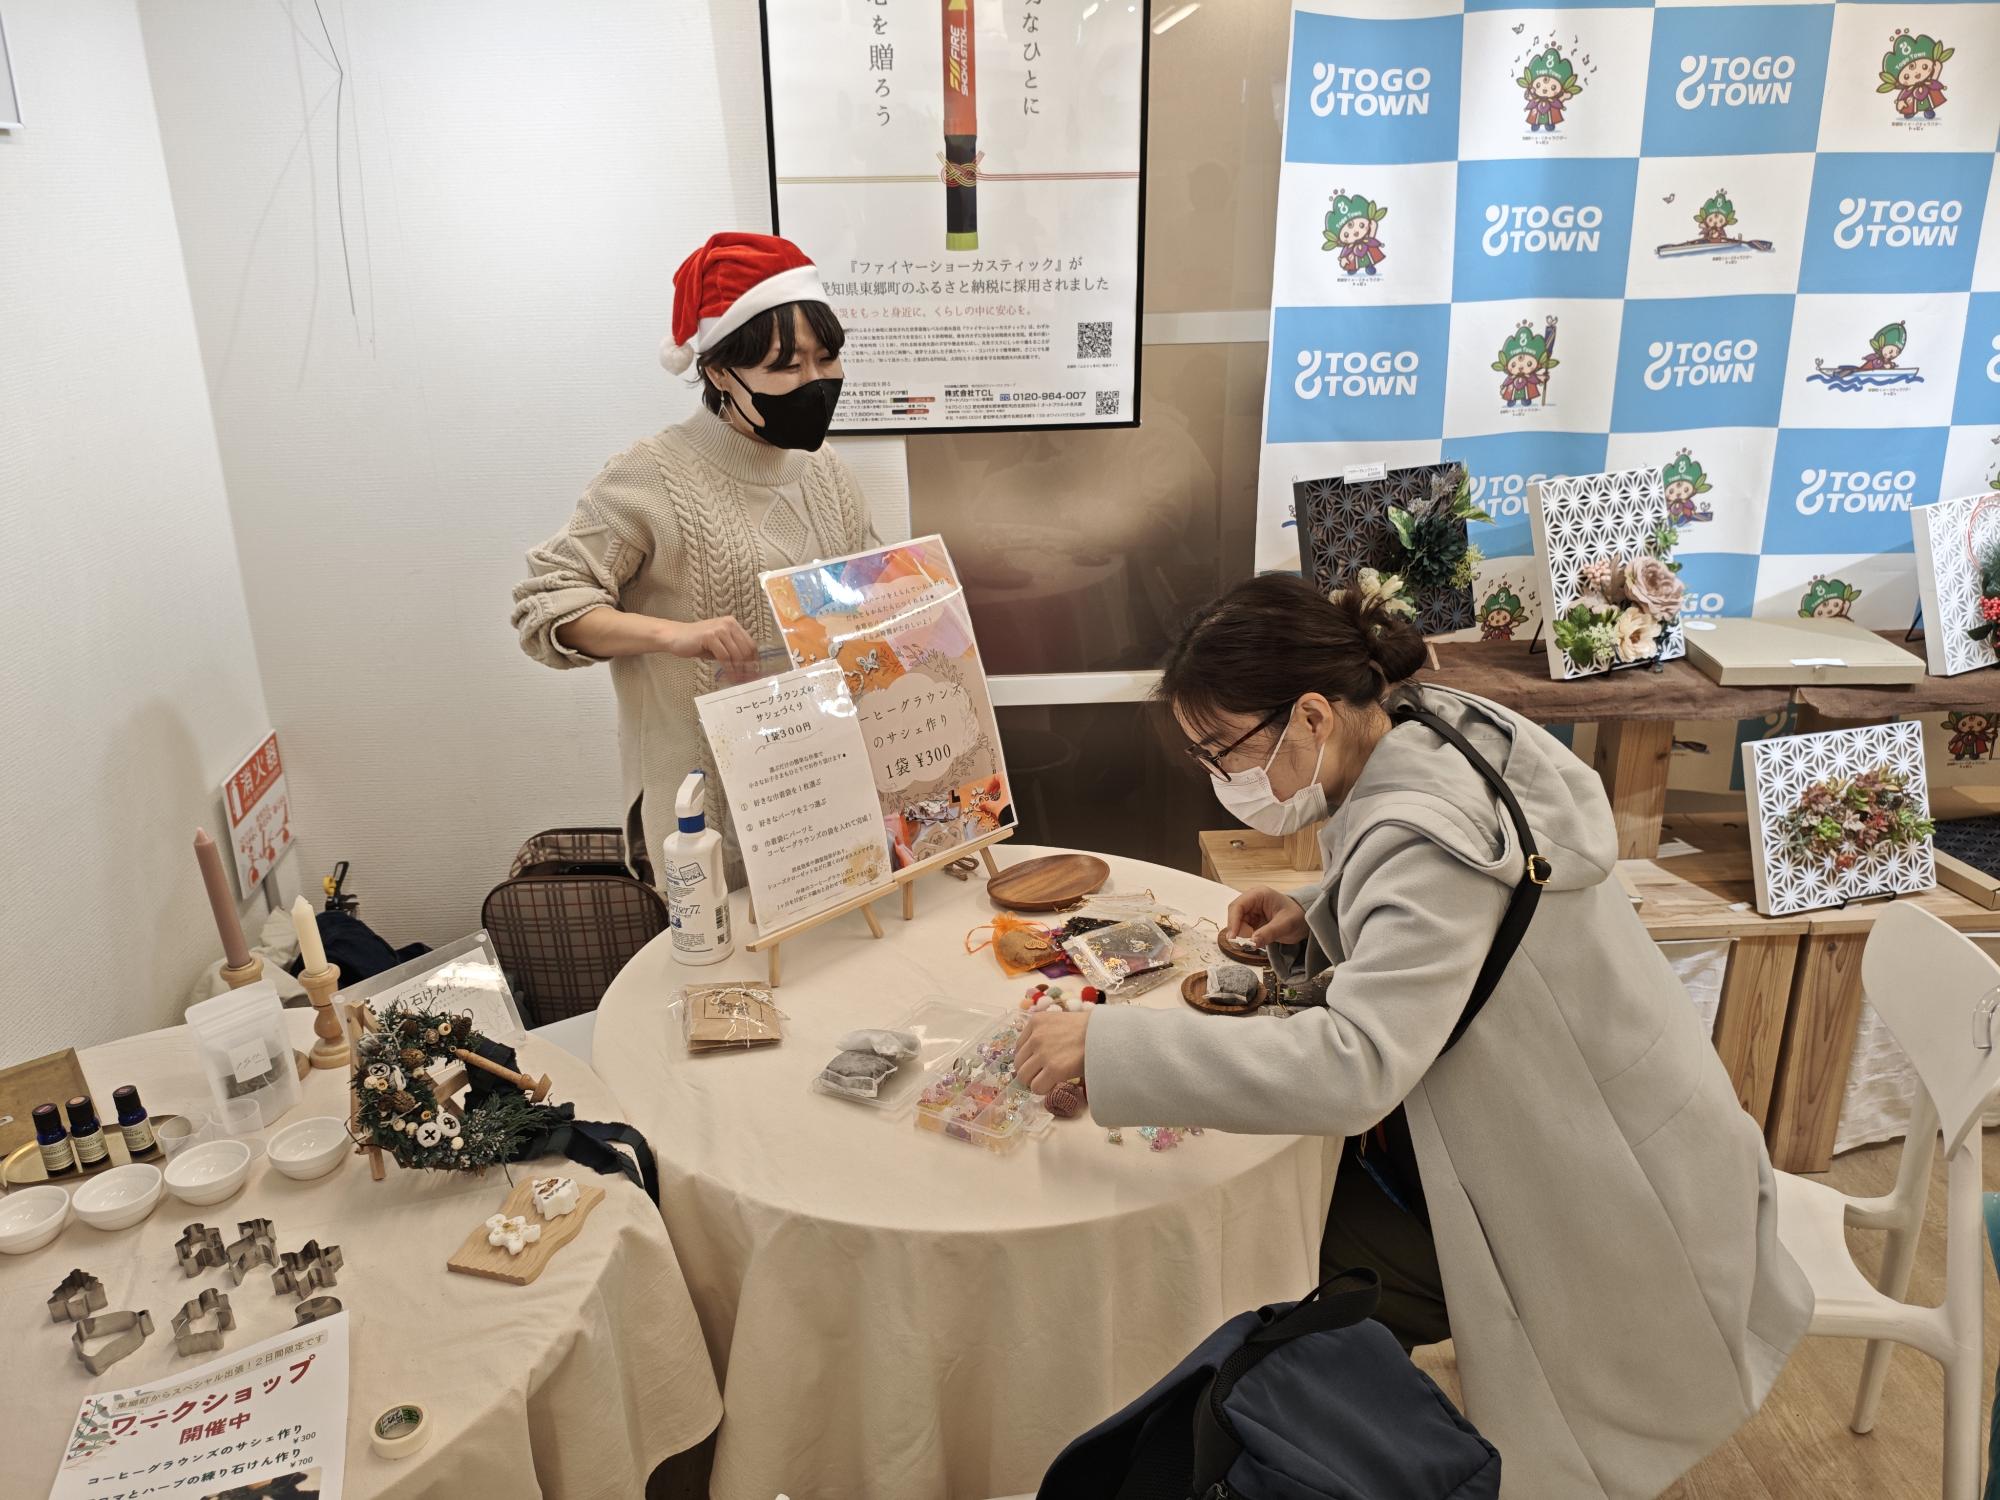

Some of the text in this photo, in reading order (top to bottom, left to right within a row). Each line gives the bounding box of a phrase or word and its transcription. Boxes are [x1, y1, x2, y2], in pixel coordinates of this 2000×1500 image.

[1338, 67, 1432, 92] TOGO
[1710, 56, 1796, 82] TOGO
[1336, 92, 1430, 117] TOWN
[1708, 82, 1793, 107] TOWN
[1511, 205, 1603, 230] TOGO
[1870, 200, 1963, 224] TOGO
[1509, 230, 1600, 253] TOWN
[1866, 224, 1958, 248] TOWN
[1325, 351, 1420, 375] TOGO
[1676, 339, 1758, 363] TOGO
[1323, 375, 1417, 397] TOWN
[1674, 363, 1755, 388] TOWN
[1488, 474, 1569, 497] TO
[1829, 470, 1917, 492] TOGO
[1487, 496, 1530, 517] TO
[1826, 492, 1914, 513] TOWN
[1680, 592, 1725, 613] GO
[756, 702, 804, 723] サシェづくり
[859, 684, 962, 722] ーヒーグラウンズ
[873, 714, 948, 748] のサシェ作り
[240, 738, 279, 800] 消火器
[111, 1353, 316, 1436] ワークショップ
[178, 1412, 251, 1446] 開催中
[293, 1431, 317, 1445] ¥300
[87, 1424, 303, 1486] コーヒーグラウンズのサシェ作り
[90, 1447, 302, 1500] マとハーブの練り石けん作り
